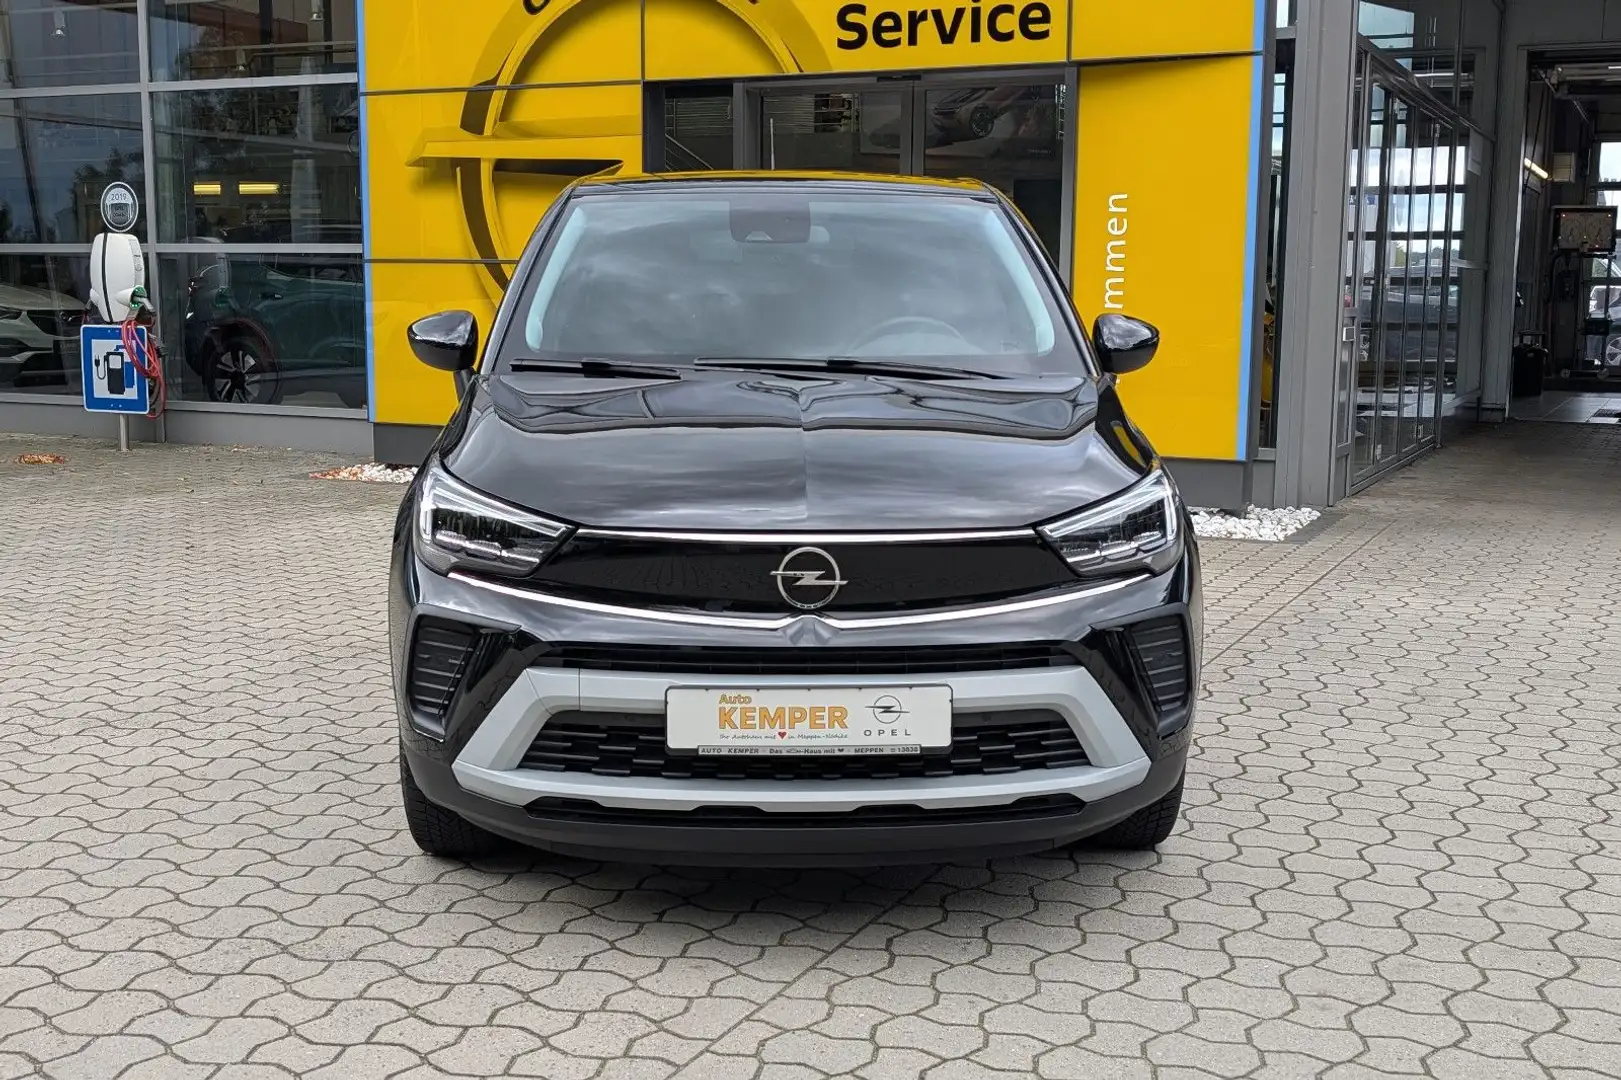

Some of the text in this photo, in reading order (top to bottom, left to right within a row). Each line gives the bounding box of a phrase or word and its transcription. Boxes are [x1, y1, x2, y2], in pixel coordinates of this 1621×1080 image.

[836, 0, 1051, 50] Service
[1104, 193, 1128, 309] mmen
[718, 694, 752, 704] Auto
[718, 706, 849, 729] KEMPER
[863, 728, 911, 736] OPEL
[854, 747, 884, 755] MEPPEN
